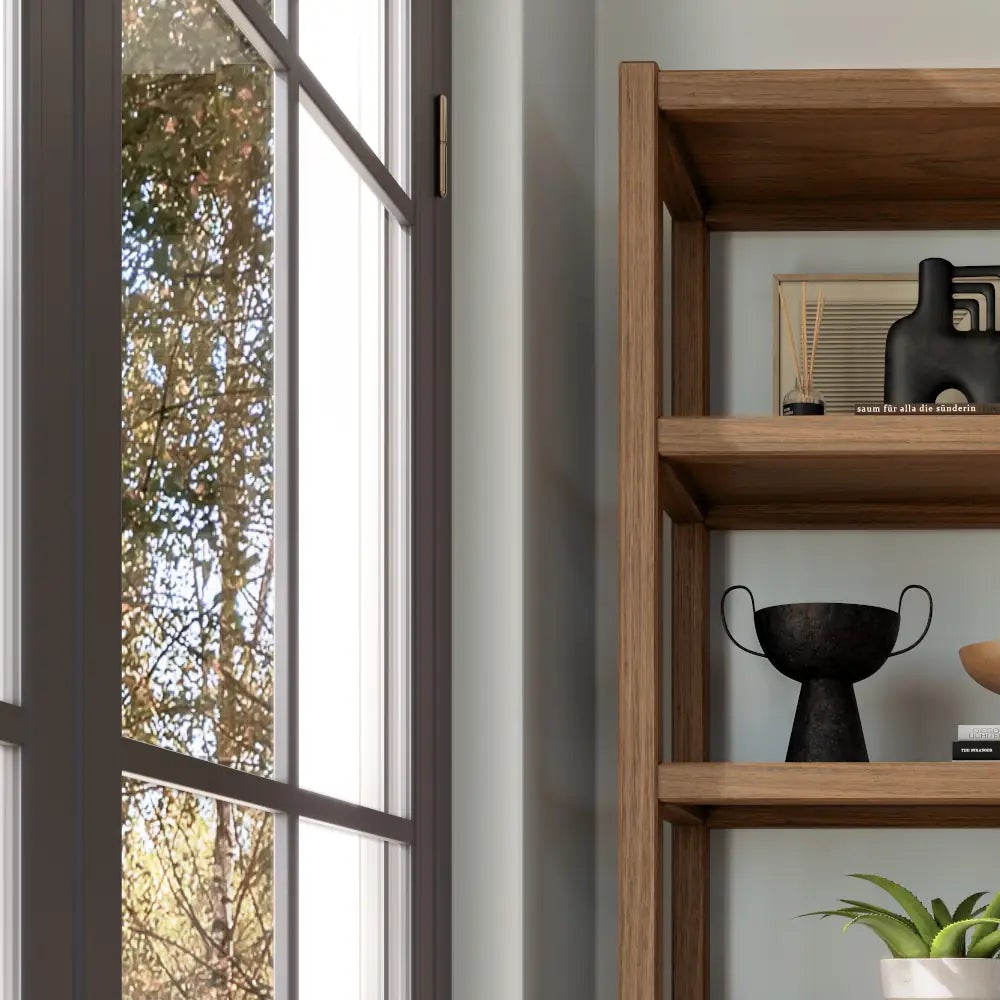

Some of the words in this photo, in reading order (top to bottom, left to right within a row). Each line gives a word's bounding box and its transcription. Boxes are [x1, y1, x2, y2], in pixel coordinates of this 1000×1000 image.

[883, 403, 898, 413] für
[899, 403, 917, 413] alla
[919, 403, 934, 413] die
[935, 403, 977, 413] sünderin
